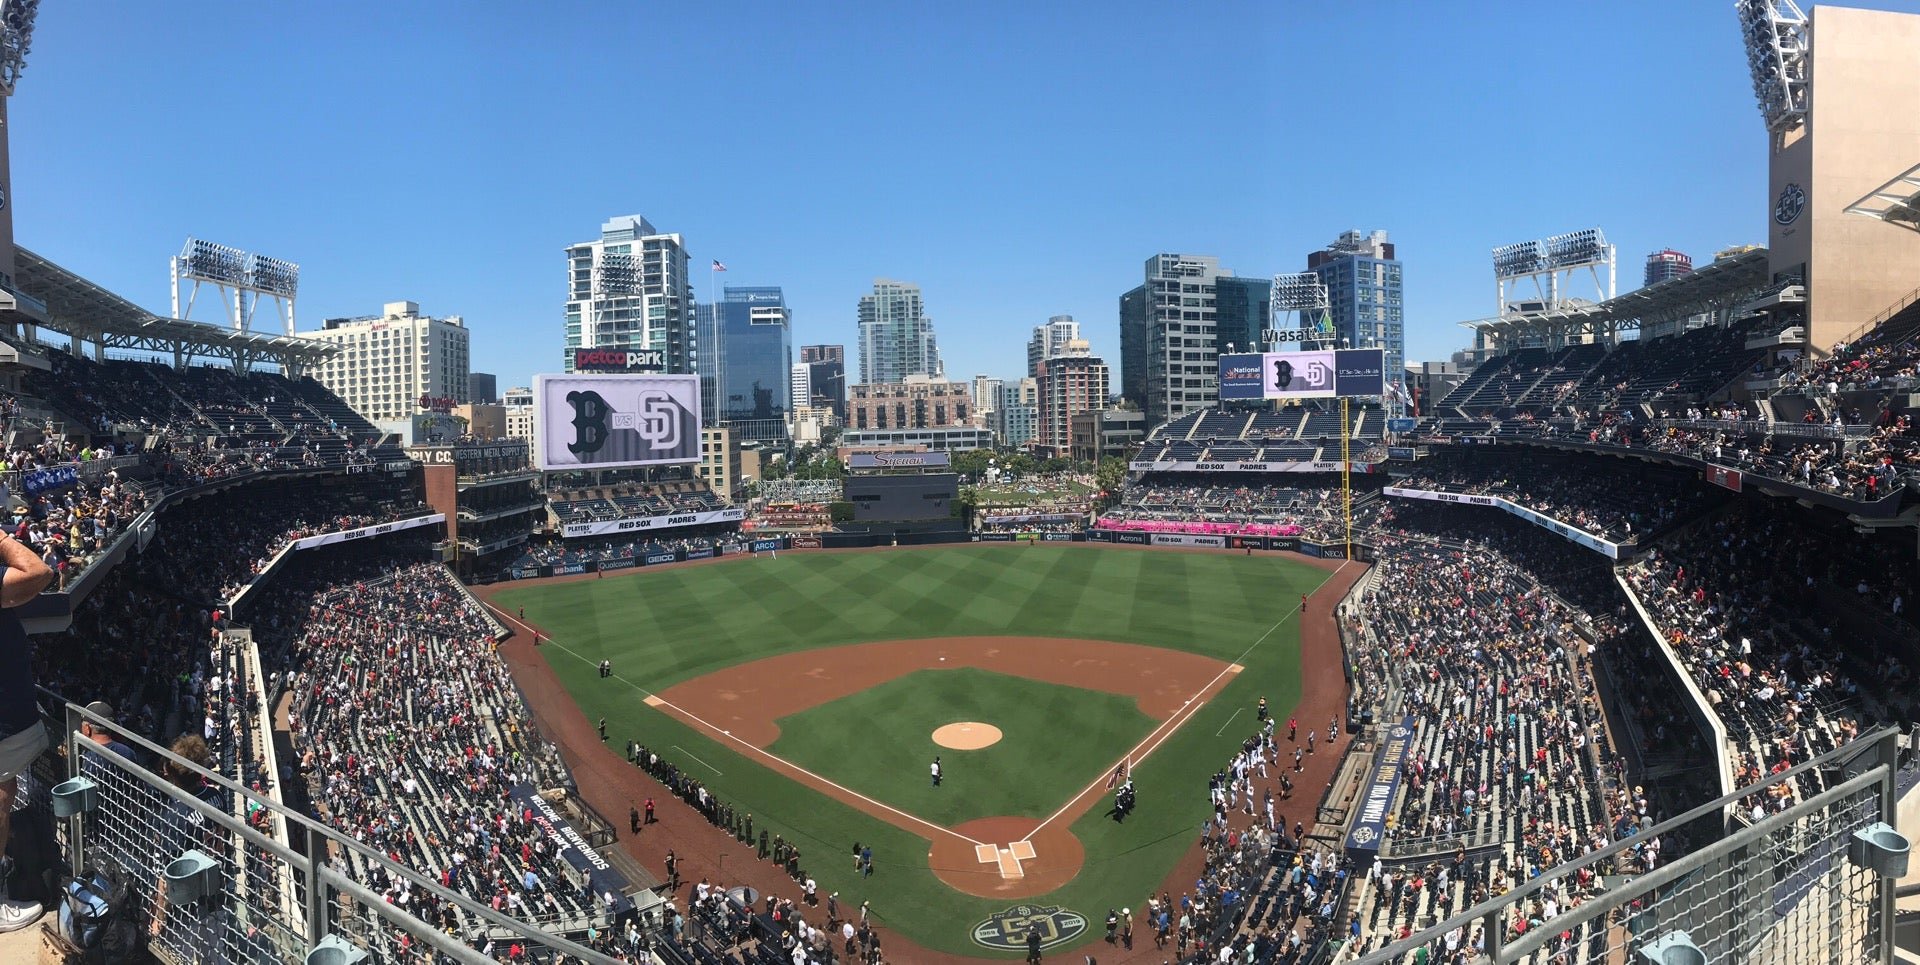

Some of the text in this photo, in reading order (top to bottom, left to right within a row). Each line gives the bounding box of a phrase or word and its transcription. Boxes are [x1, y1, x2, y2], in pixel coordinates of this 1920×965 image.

[1263, 329, 1312, 343] Viasat
[1274, 360, 1292, 387] B
[566, 390, 609, 453] B
[614, 415, 633, 427] VS
[638, 390, 680, 450] SD
[436, 450, 454, 463] CO.
[456, 448, 482, 460] WESTERN
[484, 447, 501, 458] METAL
[502, 446, 520, 457] SUPPLY
[874, 451, 926, 469] Sycuan
[1448, 494, 1459, 502] SOX
[1469, 496, 1491, 505] PADRES
[618, 521, 635, 530] RED
[636, 519, 651, 528] SOX
[668, 516, 696, 525] PADRES
[344, 530, 356, 540] RED
[355, 529, 366, 538] SOX
[375, 524, 392, 534] PADRES
[755, 542, 775, 550] ARCO
[647, 554, 675, 564] GEICO
[1324, 550, 1344, 558] NECA
[600, 560, 633, 570] Qualcomm
[1376, 765, 1397, 783] FRIAR
[1370, 784, 1391, 799] YOU
[1361, 799, 1387, 822] THANK
[530, 794, 610, 871] WELCOME BIENVENIDOS
